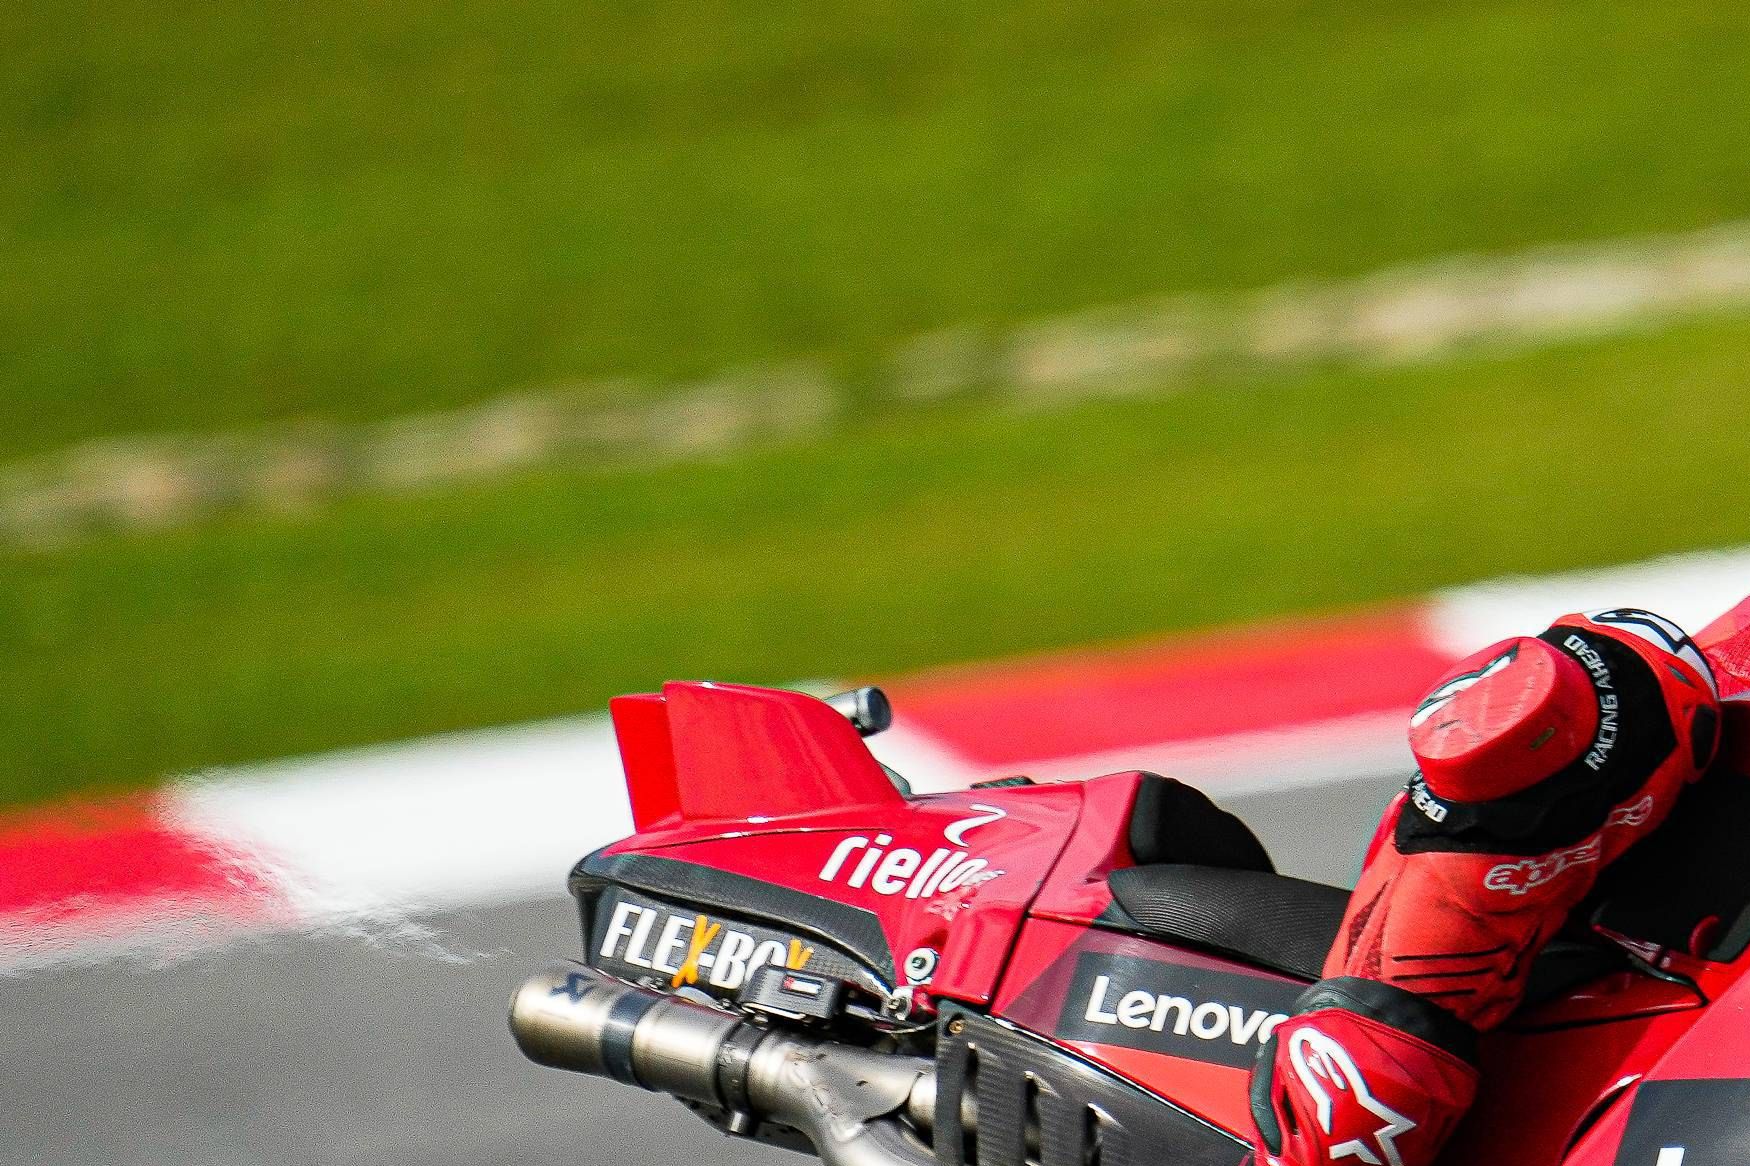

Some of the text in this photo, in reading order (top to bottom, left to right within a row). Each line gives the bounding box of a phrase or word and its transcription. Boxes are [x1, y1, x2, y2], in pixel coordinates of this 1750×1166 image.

[1564, 635, 1613, 689] AHEAD
[1584, 694, 1619, 771] RACING
[819, 833, 989, 899] riello
